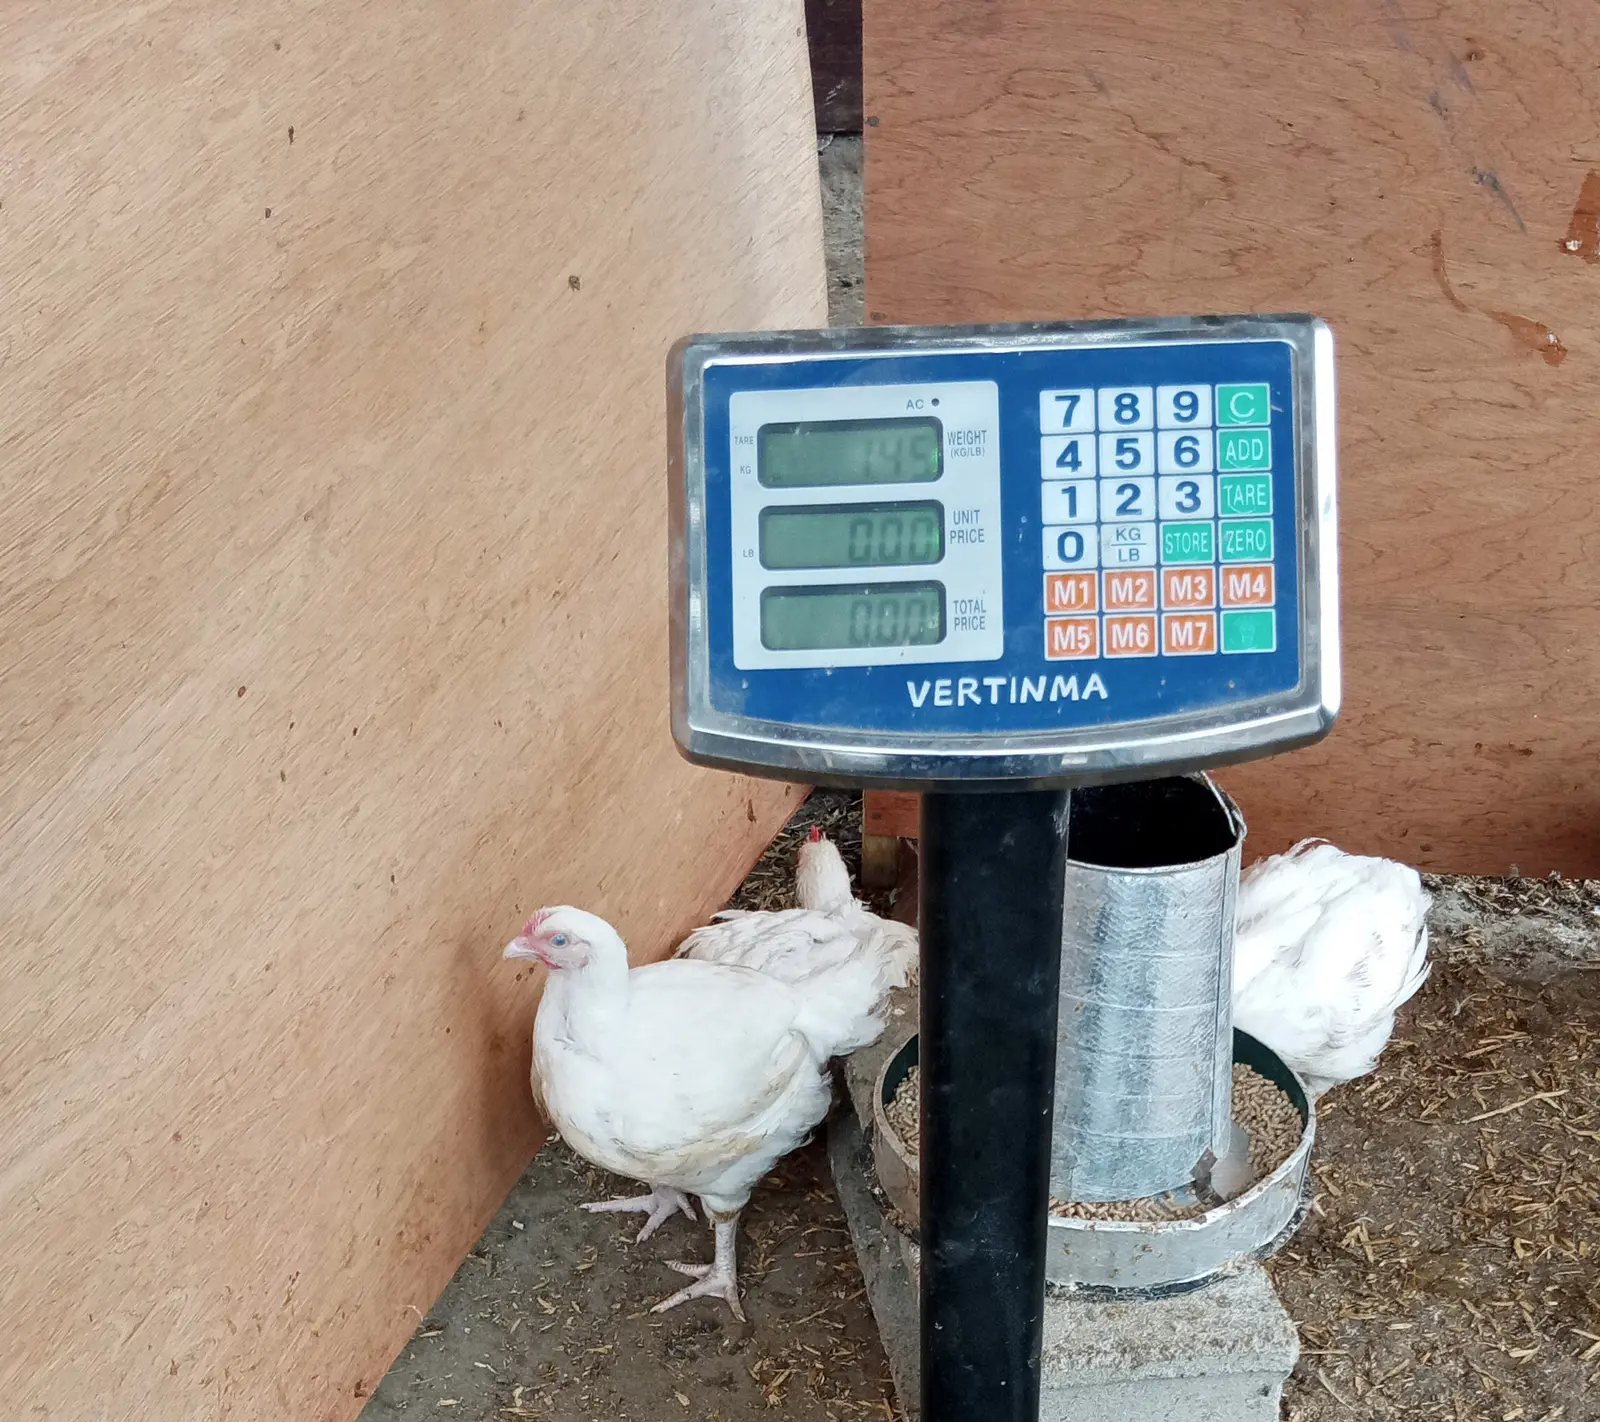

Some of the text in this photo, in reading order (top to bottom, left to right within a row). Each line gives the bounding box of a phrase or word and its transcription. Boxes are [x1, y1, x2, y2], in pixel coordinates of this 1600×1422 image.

[906, 399, 925, 410] AC
[1055, 394, 1081, 428] 7
[1114, 392, 1140, 425] 8
[1172, 390, 1199, 423] 9
[1229, 391, 1255, 418] C
[734, 436, 754, 445] TARE
[947, 430, 987, 445] WEIGHT
[1225, 438, 1264, 461] ADD
[950, 446, 985, 458] (KG/LB)
[1056, 440, 1082, 473] 4
[1115, 438, 1141, 470] 5
[1173, 435, 1200, 468] 6
[740, 465, 752, 475] KG
[1061, 485, 1077, 518] 1
[1115, 483, 1142, 516] 2
[1175, 481, 1201, 514] 3
[1223, 484, 1267, 507] TARE
[953, 509, 981, 525] UNIT
[949, 528, 985, 544] PRICE
[1116, 527, 1141, 541] KG
[1165, 532, 1209, 554] STORE
[1226, 528, 1267, 553] ZERO
[743, 548, 754, 558] LB
[1057, 531, 1084, 563] 0
[1118, 548, 1140, 562] LB
[1054, 579, 1089, 605] M1
[1112, 577, 1148, 604] M2
[1170, 575, 1207, 601] M3
[1228, 573, 1266, 600] M4
[953, 599, 986, 614] TOTAL
[954, 615, 986, 631] PRICE
[1112, 623, 1149, 648] M6
[1171, 621, 1207, 647] M7
[1054, 625, 1091, 650] M5
[907, 673, 1108, 708] VERTINMA
